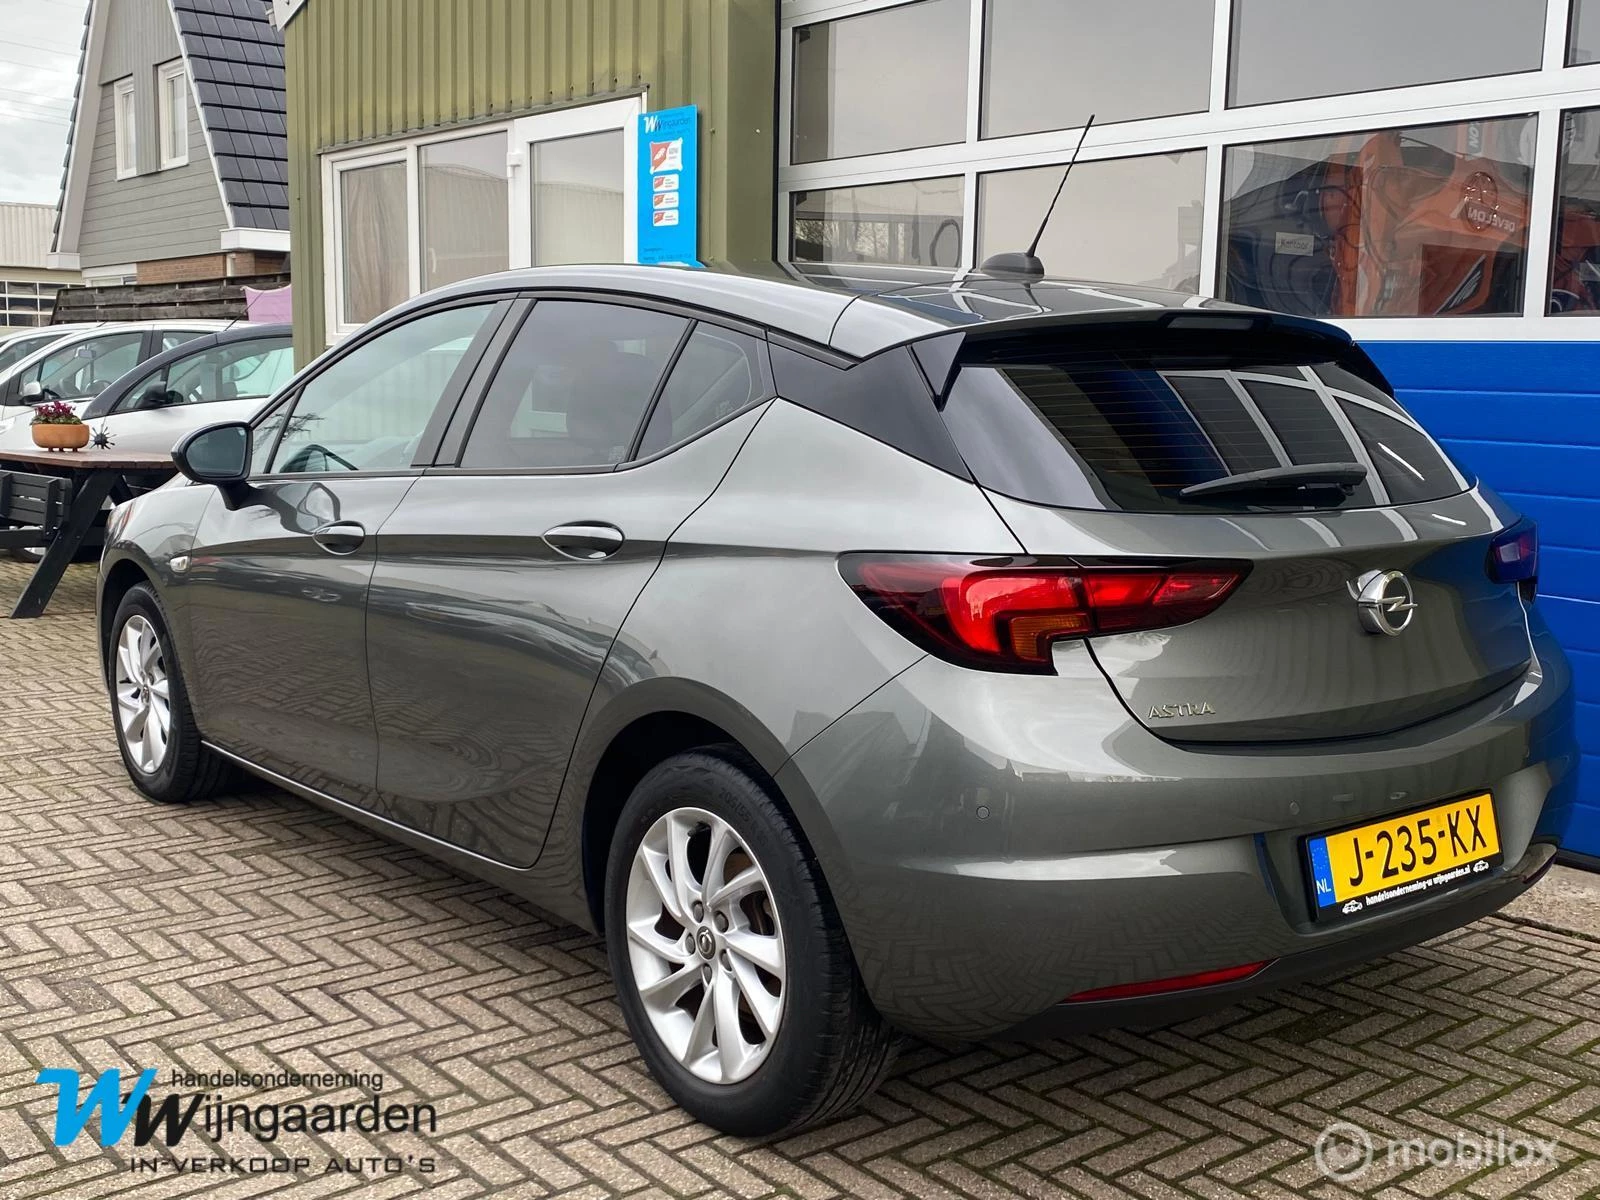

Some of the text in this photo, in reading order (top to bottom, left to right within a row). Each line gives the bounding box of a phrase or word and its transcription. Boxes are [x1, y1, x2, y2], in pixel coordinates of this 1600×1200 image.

[1148, 702, 1216, 719] ASTRA
[1349, 804, 1488, 887] J-235-KX
[1316, 880, 1332, 895] NL
